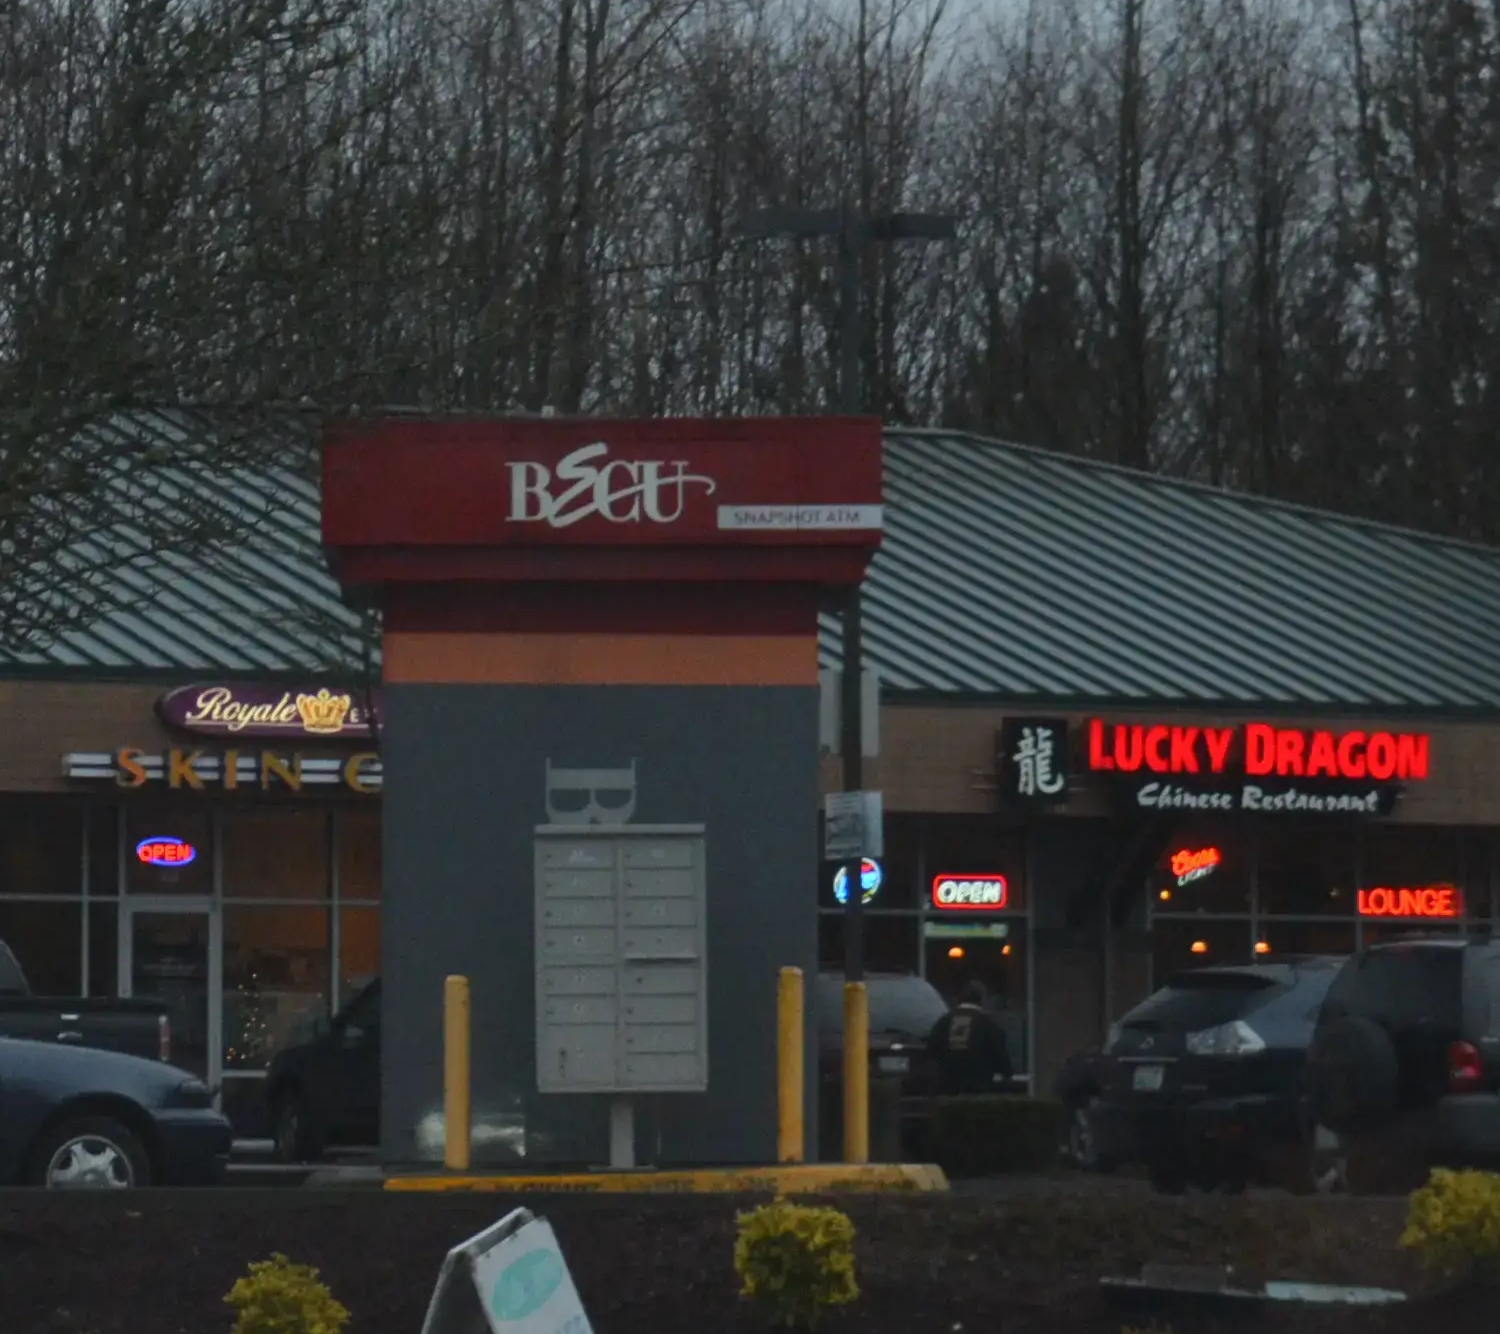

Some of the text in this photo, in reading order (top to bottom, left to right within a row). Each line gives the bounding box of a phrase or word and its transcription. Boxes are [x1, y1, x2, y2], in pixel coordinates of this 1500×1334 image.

[504, 441, 716, 529] BECU
[734, 509, 861, 524] SNAPSHOT ATM
[185, 687, 297, 731] Royale
[1012, 725, 1064, 797] 龍
[1088, 718, 1430, 780] LUCKY DRAGON
[116, 747, 302, 791] SKIN
[1137, 781, 1381, 813] Chinese Restaurant
[138, 843, 191, 863] OPEN
[937, 880, 1003, 904] OPEN
[1357, 887, 1454, 916] LOUNGE
